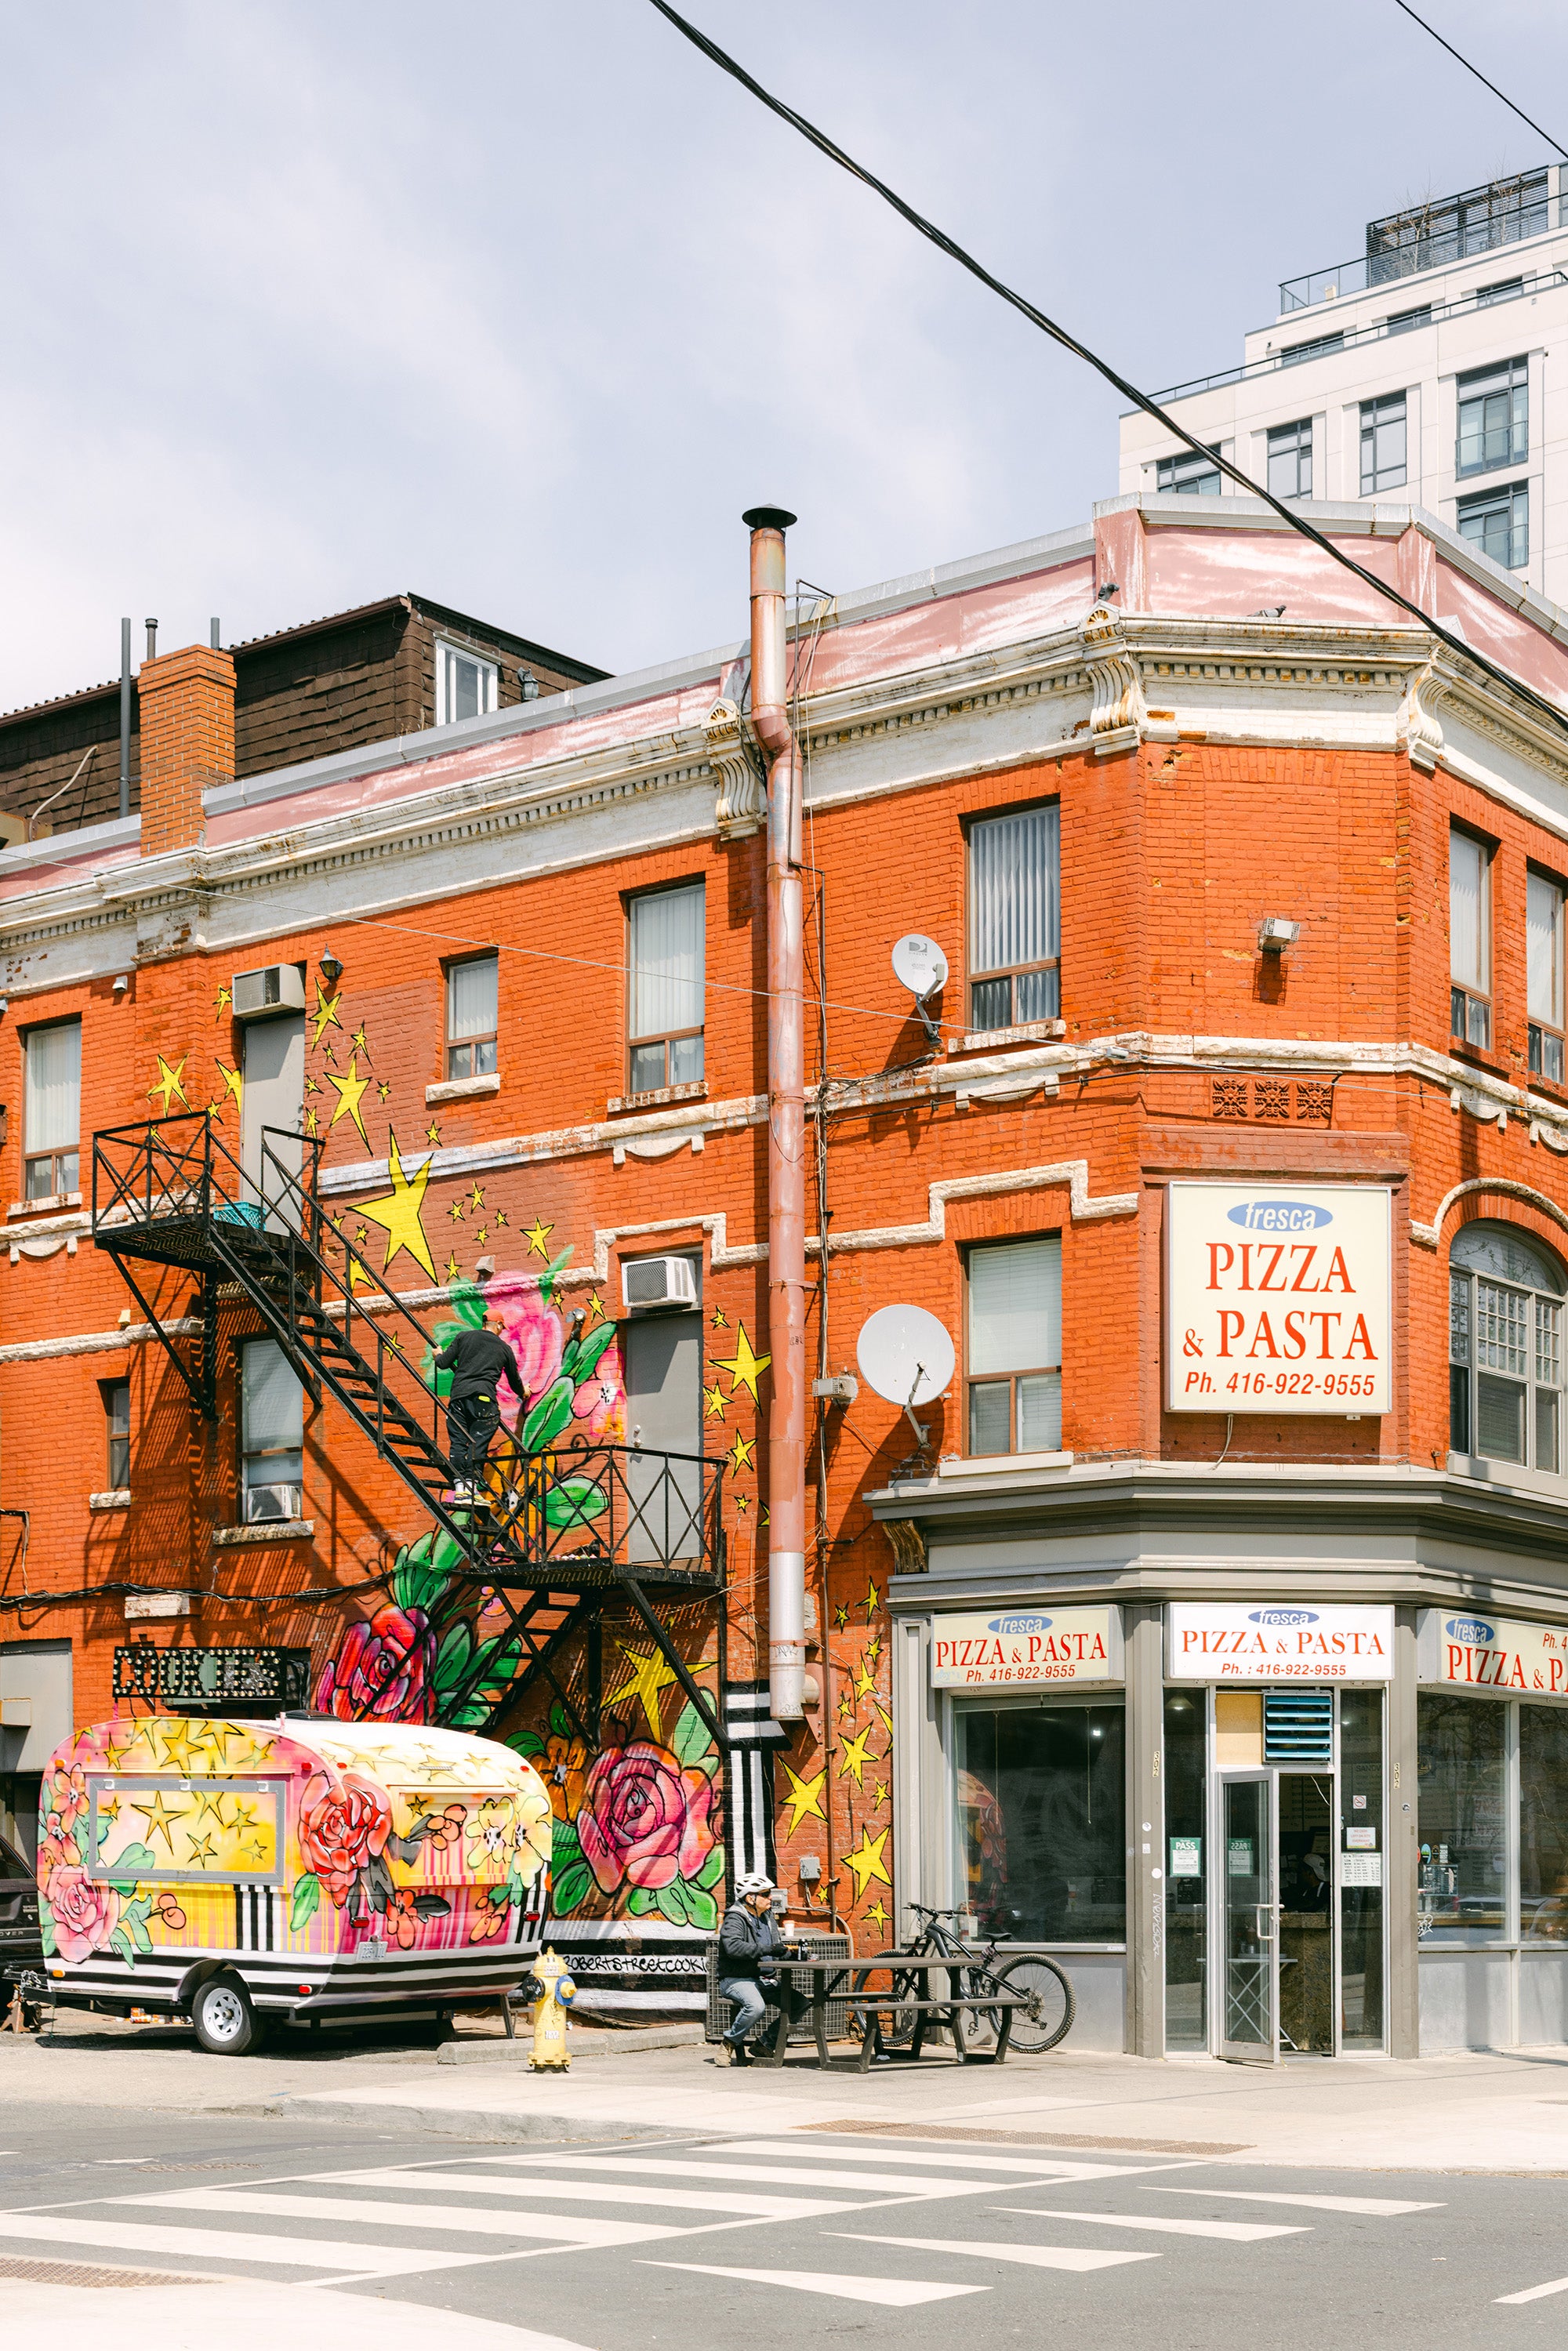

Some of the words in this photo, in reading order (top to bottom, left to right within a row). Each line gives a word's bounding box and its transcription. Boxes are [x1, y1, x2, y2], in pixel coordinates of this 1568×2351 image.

[1244, 1202, 1316, 1231] fresca
[1205, 1243, 1356, 1293] PIZZA
[1182, 1328, 1204, 1358] &
[1216, 1310, 1378, 1360] PASTA
[1185, 1372, 1217, 1393] Ph.
[1226, 1372, 1375, 1396] 416-922-9555
[998, 1617, 1043, 1634] fresca
[1259, 1609, 1309, 1625] fresca
[1181, 1631, 1268, 1653] PIZZA
[1276, 1638, 1288, 1653] &
[1297, 1631, 1385, 1655] PASTA
[1453, 1619, 1487, 1643] fresca
[1543, 1633, 1558, 1649] Ph.
[935, 1638, 1007, 1667] PIZZA
[1011, 1647, 1022, 1663] &
[1028, 1632, 1107, 1663] PASTA
[112, 1648, 282, 1698] COOKIES
[966, 1670, 985, 1682] Ph.
[989, 1663, 1076, 1681] 416-922-9555
[1221, 1663, 1243, 1674] Ph.
[1256, 1663, 1346, 1675] 416-922-9555
[1446, 1644, 1528, 1689] PIZZA
[1534, 1668, 1544, 1689] &
[1548, 1658, 1568, 1693] P
[1176, 1841, 1196, 1850] PASS
